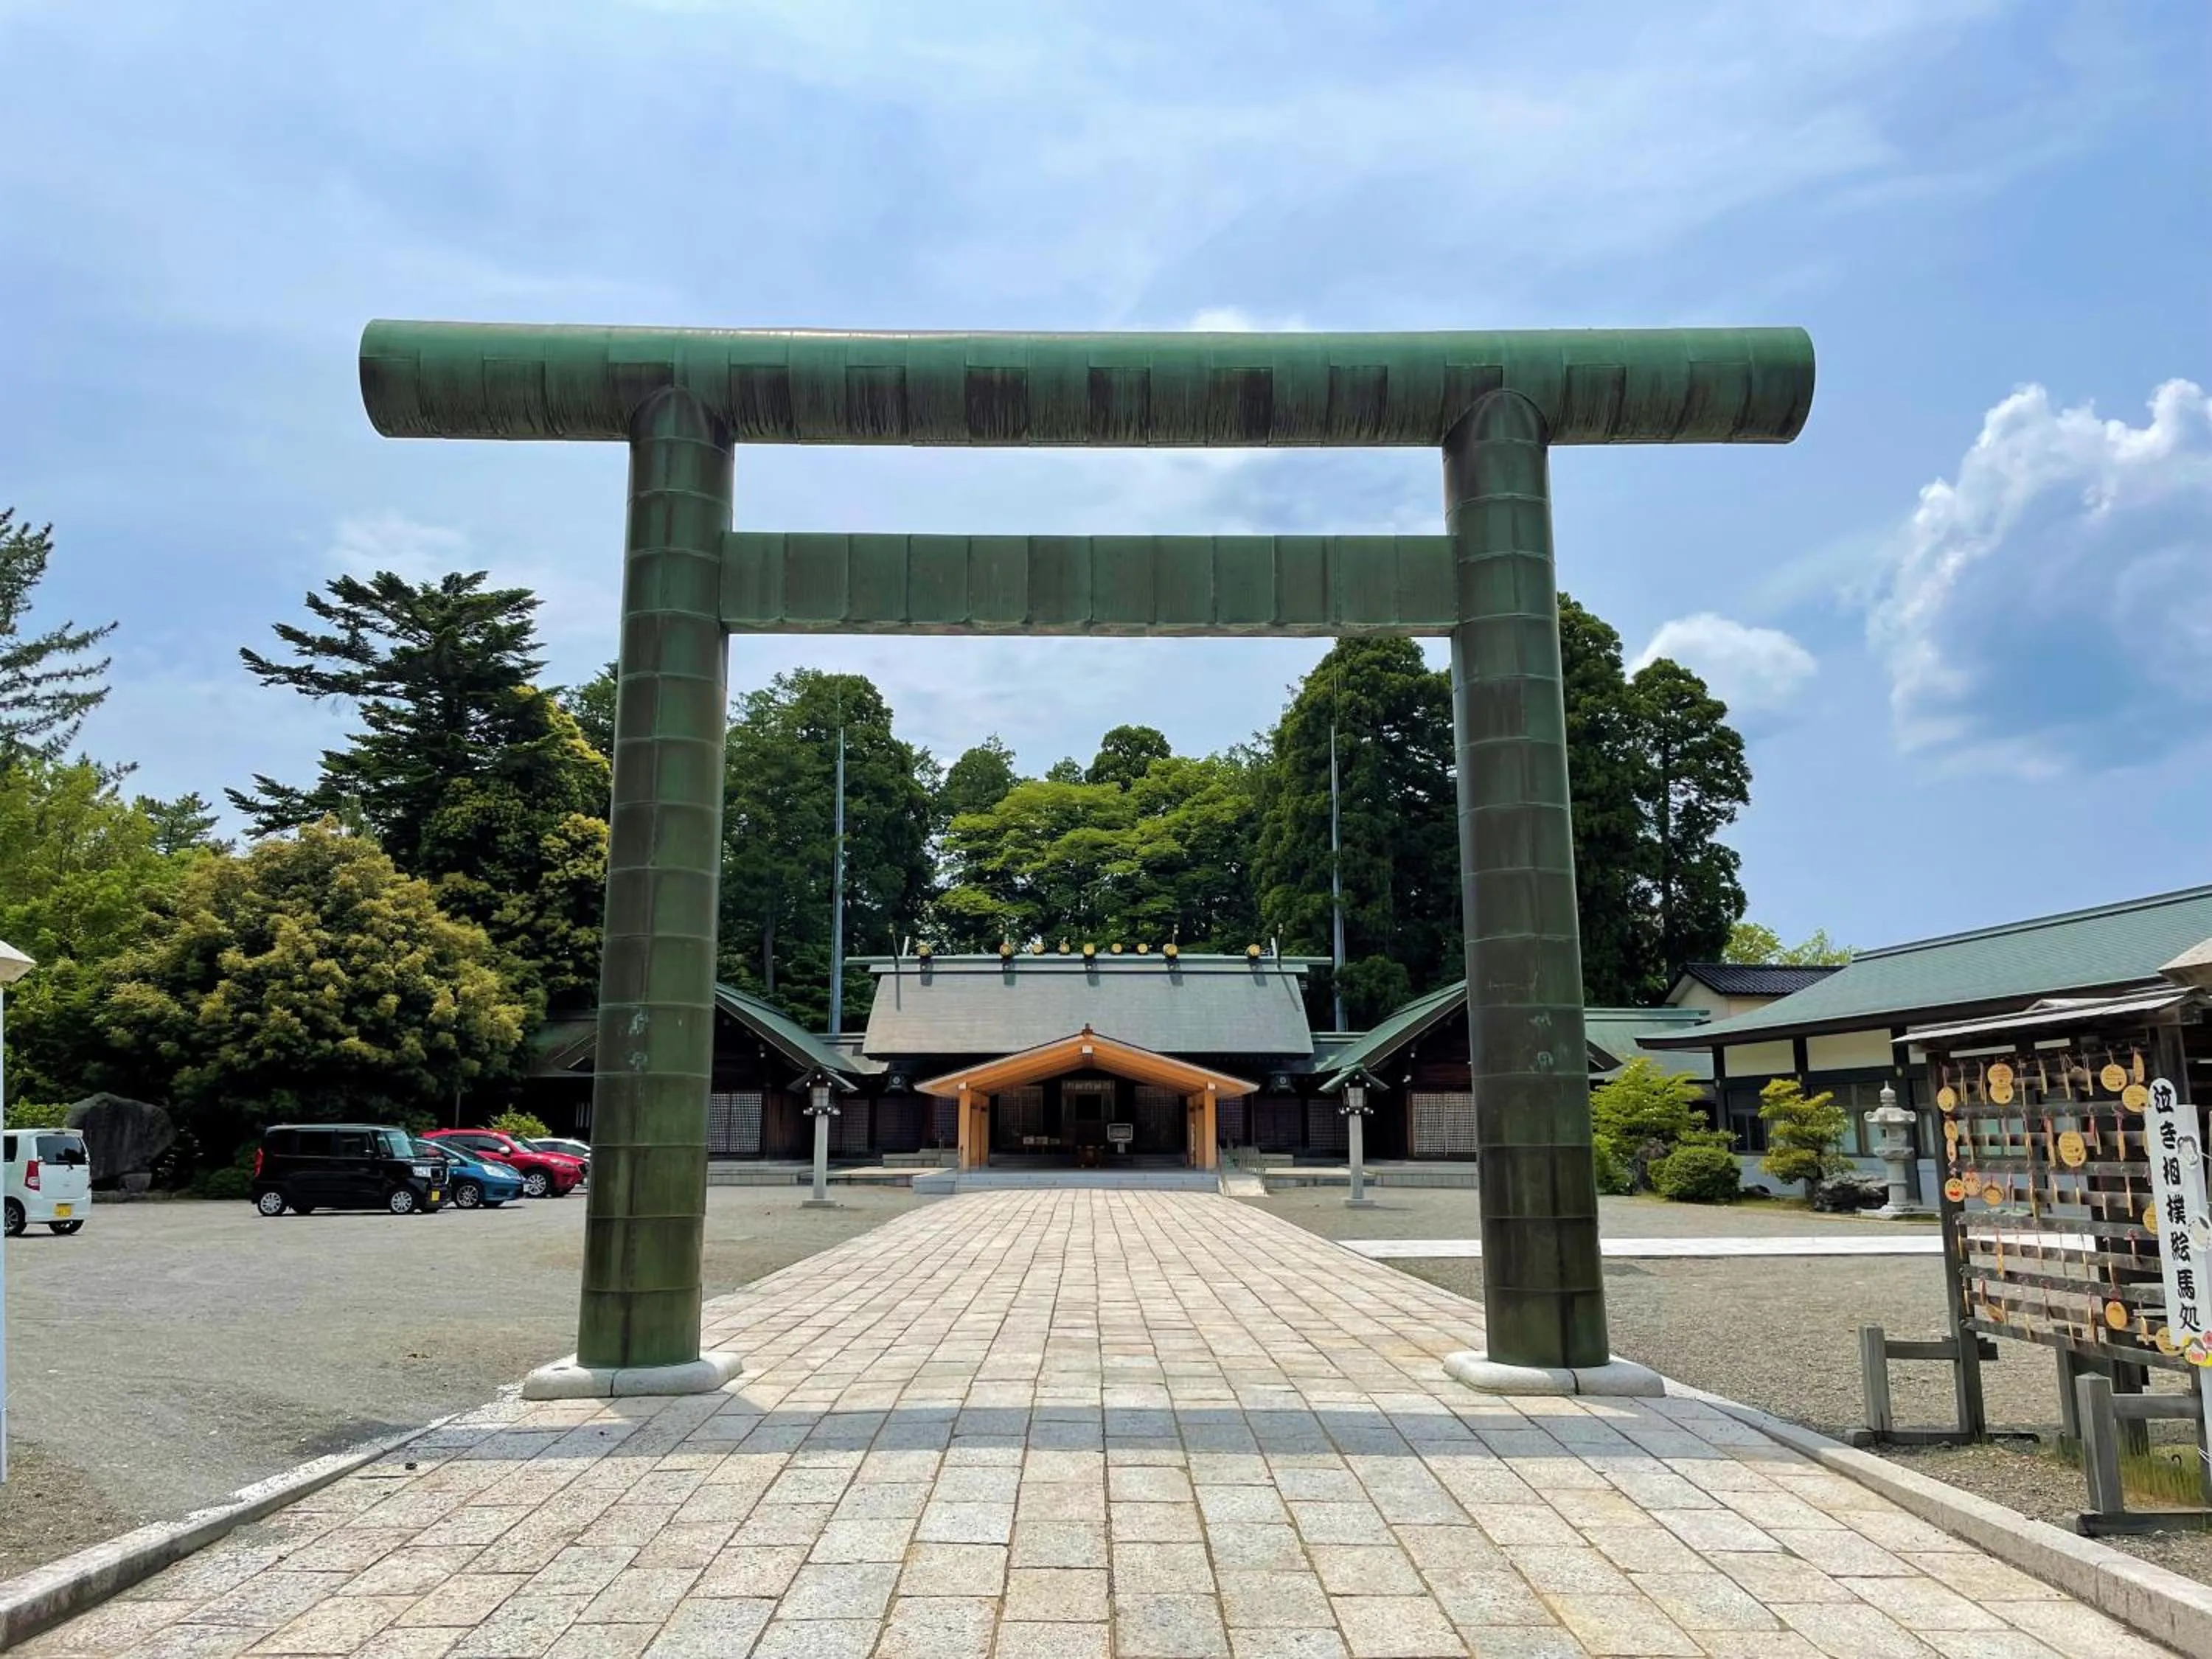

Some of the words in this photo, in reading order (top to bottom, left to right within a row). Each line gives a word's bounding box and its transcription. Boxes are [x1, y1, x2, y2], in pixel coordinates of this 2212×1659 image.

[2152, 1085, 2202, 1332] 泣き相撲絵馬処
